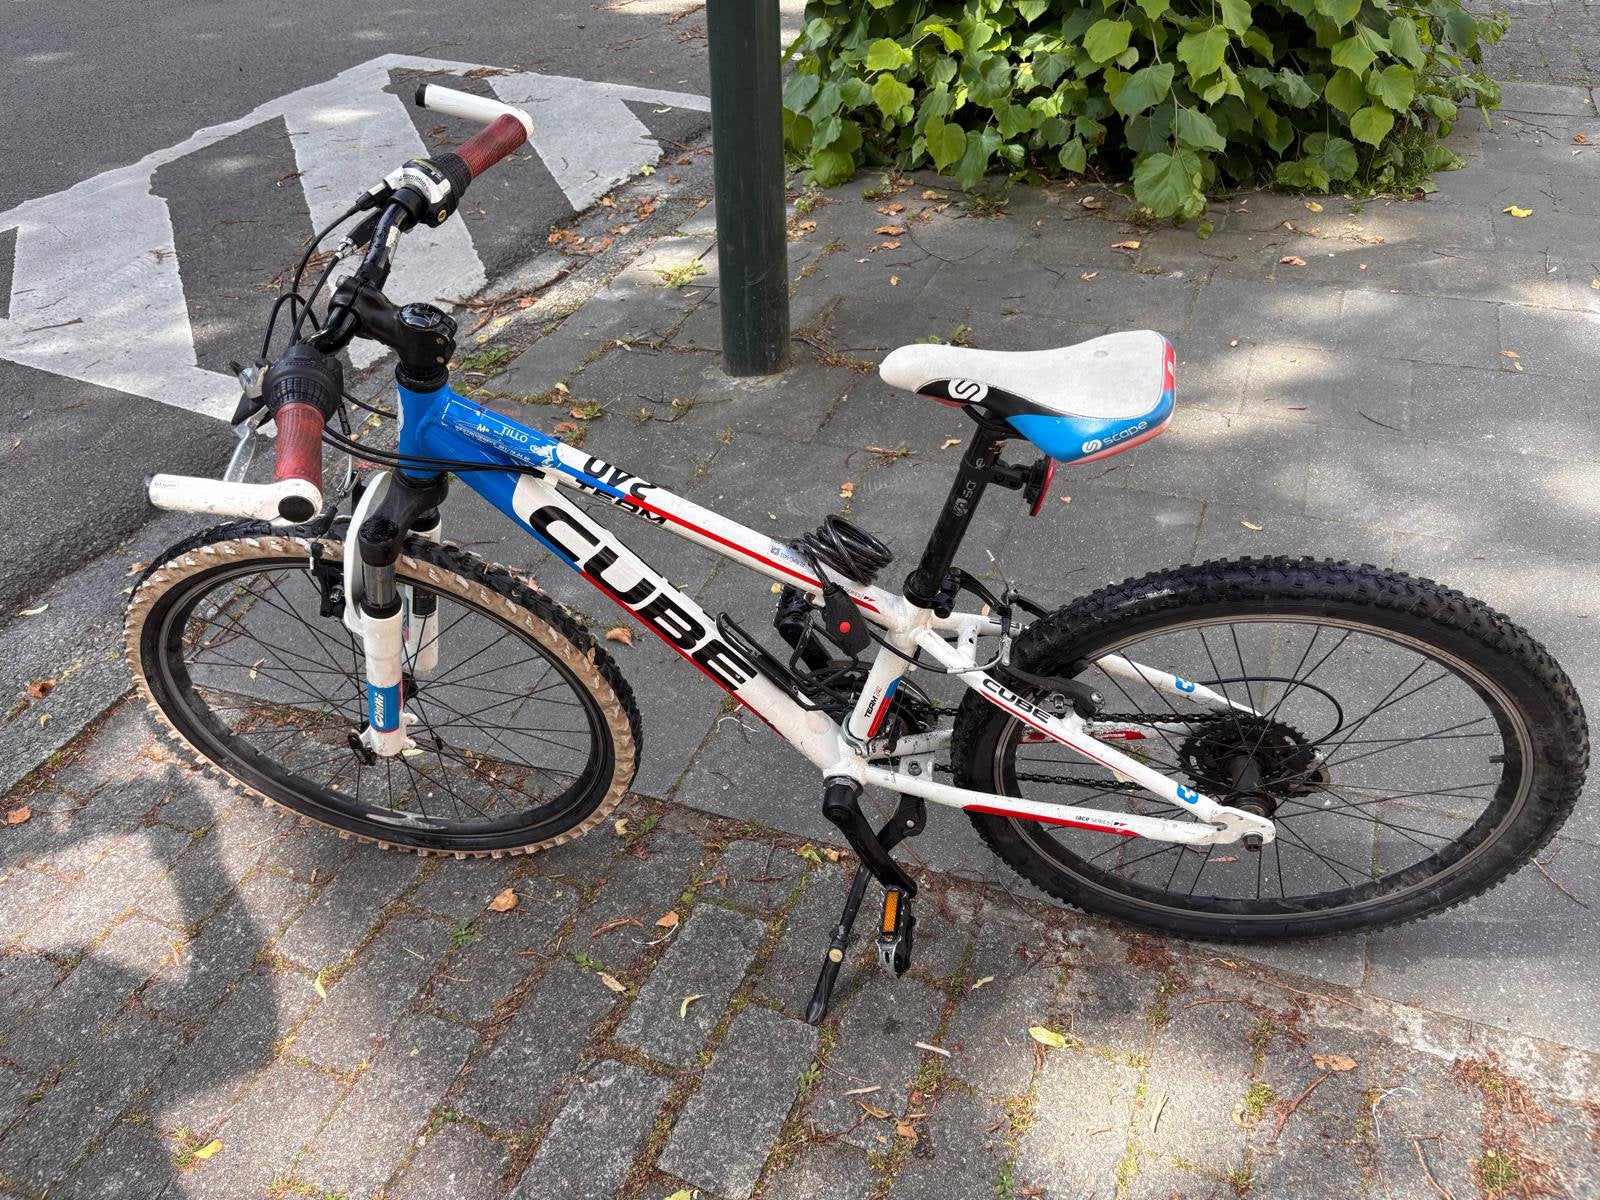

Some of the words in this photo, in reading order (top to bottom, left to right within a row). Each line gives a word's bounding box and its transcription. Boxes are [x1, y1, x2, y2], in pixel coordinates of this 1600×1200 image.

[1102, 421, 1148, 446] scape
[529, 505, 758, 691] CUBE
[864, 695, 879, 718] TEAM
[982, 678, 1051, 724] CUBE
